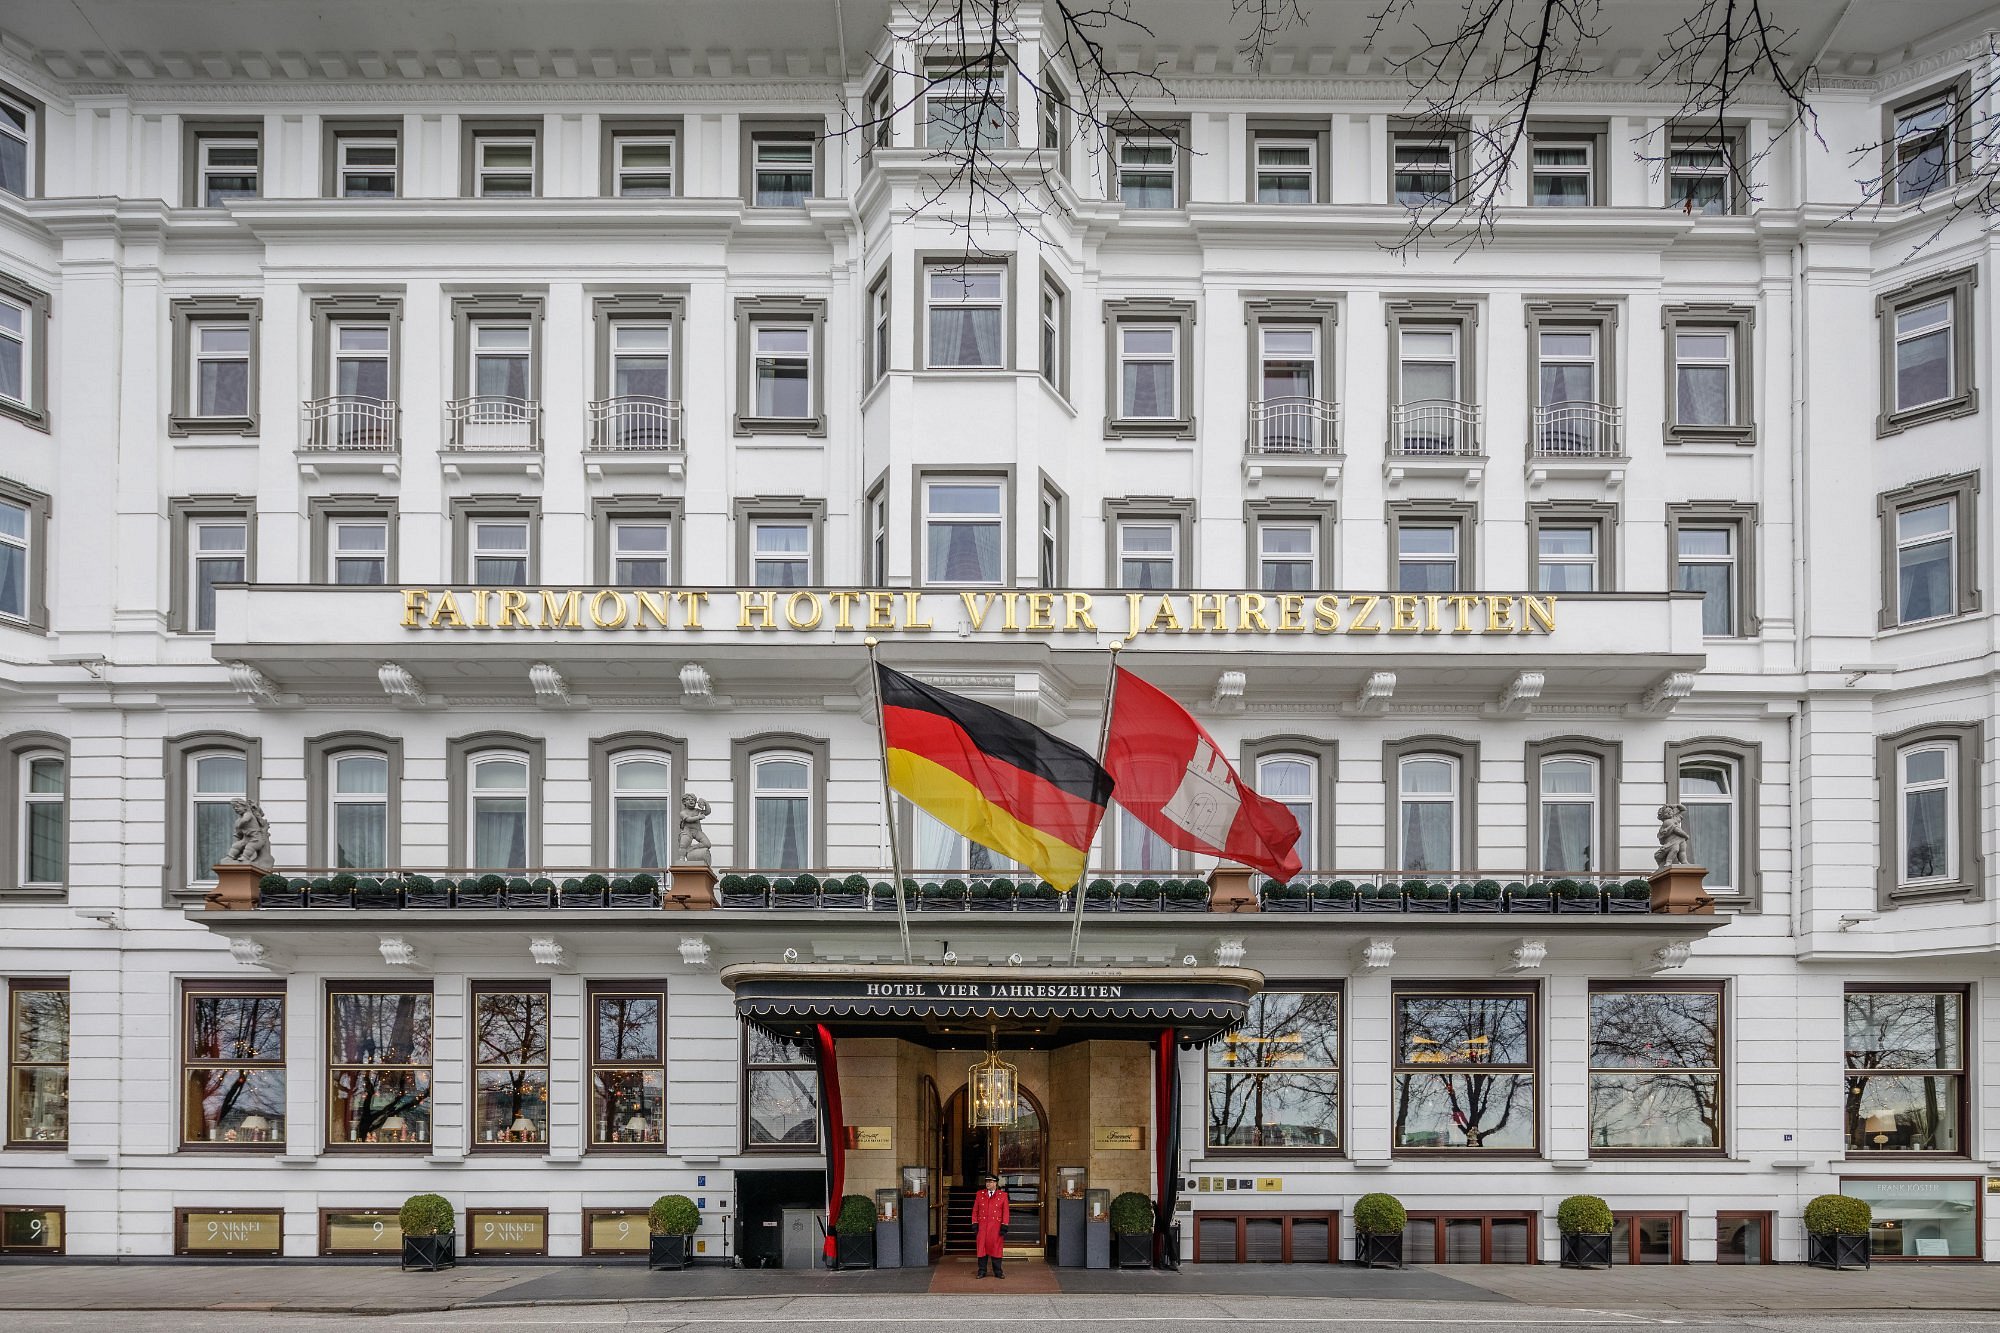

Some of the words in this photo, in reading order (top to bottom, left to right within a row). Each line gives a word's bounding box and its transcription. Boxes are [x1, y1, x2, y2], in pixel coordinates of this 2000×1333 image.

[400, 589, 709, 630] FAIRMONT
[736, 590, 934, 632] HOTEL
[959, 591, 1098, 632] VIER
[1123, 592, 1558, 642] JAHRESZEITEN
[867, 983, 926, 996] HOTEL
[937, 984, 980, 996] VIER
[990, 984, 1122, 998] JAHRESZEITEN
[1876, 1183, 1905, 1192] FRANK
[222, 1231, 249, 1241] NINE
[498, 1231, 524, 1241] NINE
